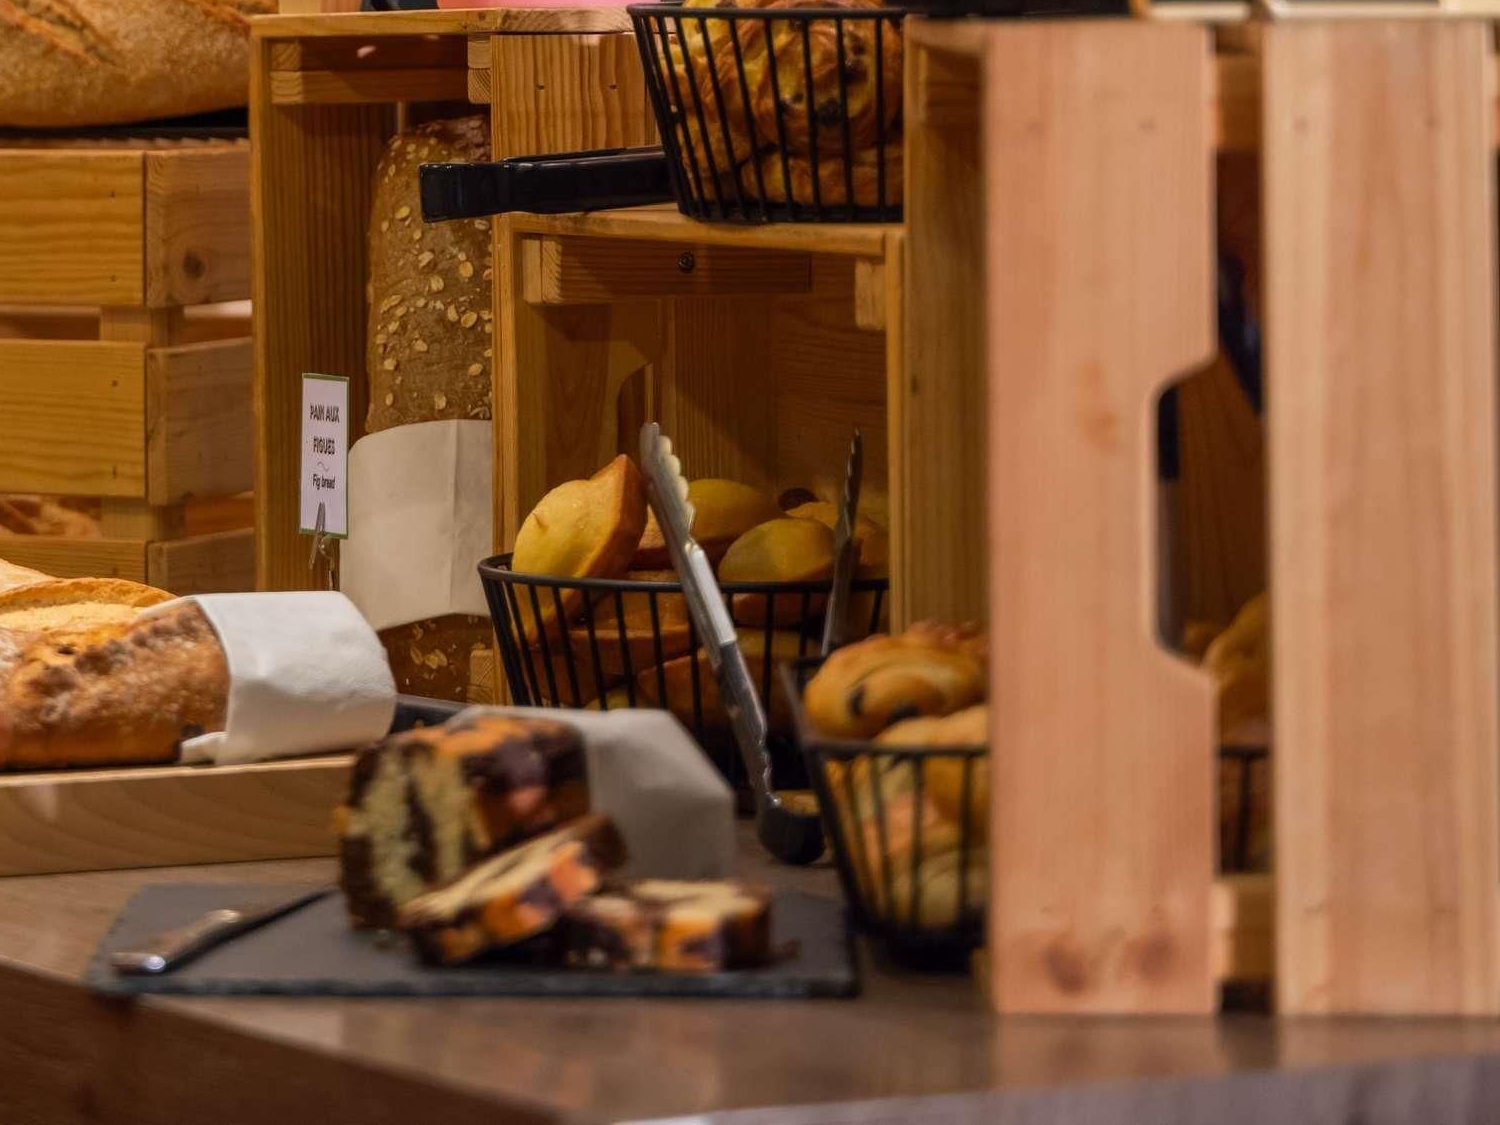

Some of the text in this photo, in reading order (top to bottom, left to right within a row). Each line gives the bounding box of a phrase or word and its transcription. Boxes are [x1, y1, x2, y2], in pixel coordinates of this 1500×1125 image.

[310, 404, 340, 423] PAIN AUX
[313, 436, 335, 454] FIGUES
[312, 474, 335, 490] Fig bread
